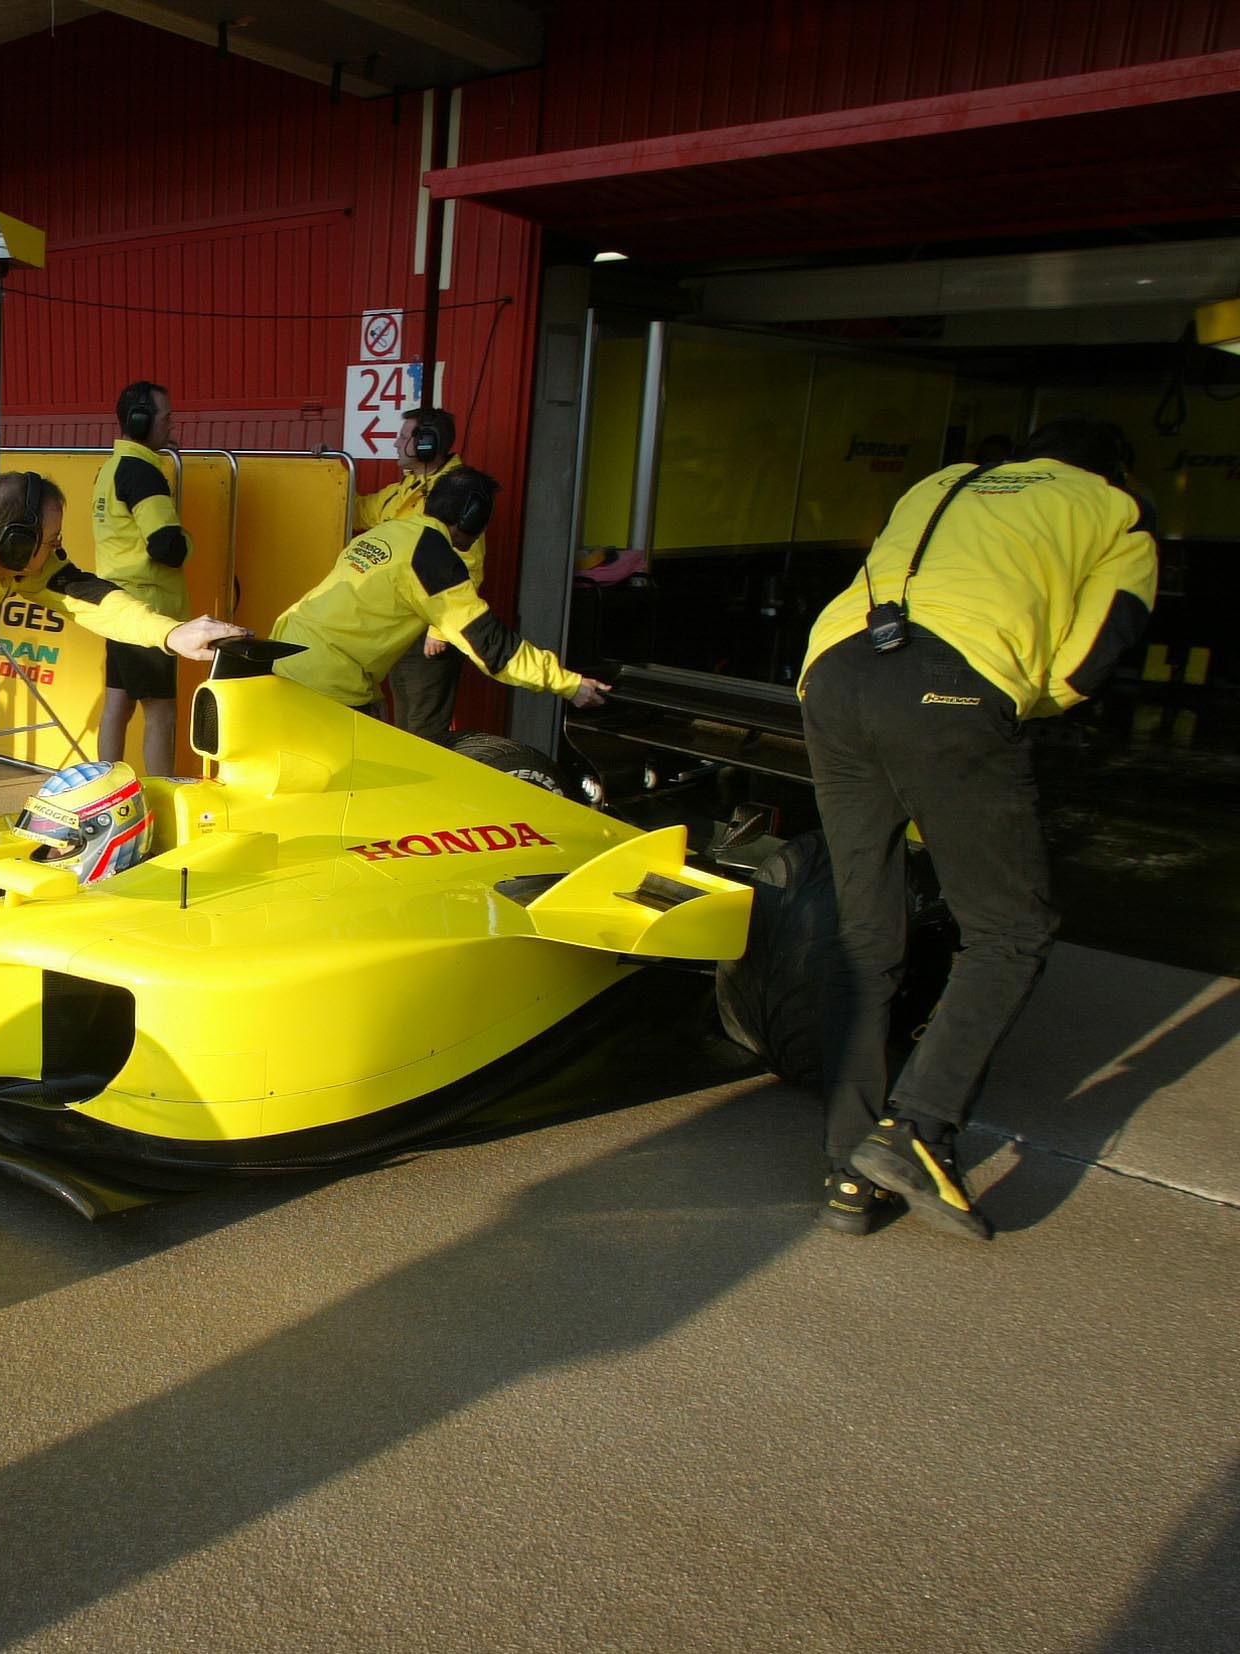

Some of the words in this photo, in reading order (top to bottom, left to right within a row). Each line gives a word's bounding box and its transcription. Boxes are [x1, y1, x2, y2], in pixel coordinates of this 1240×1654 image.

[357, 367, 406, 411] 24
[0, 601, 64, 633] GES
[346, 822, 556, 861] HONDA
